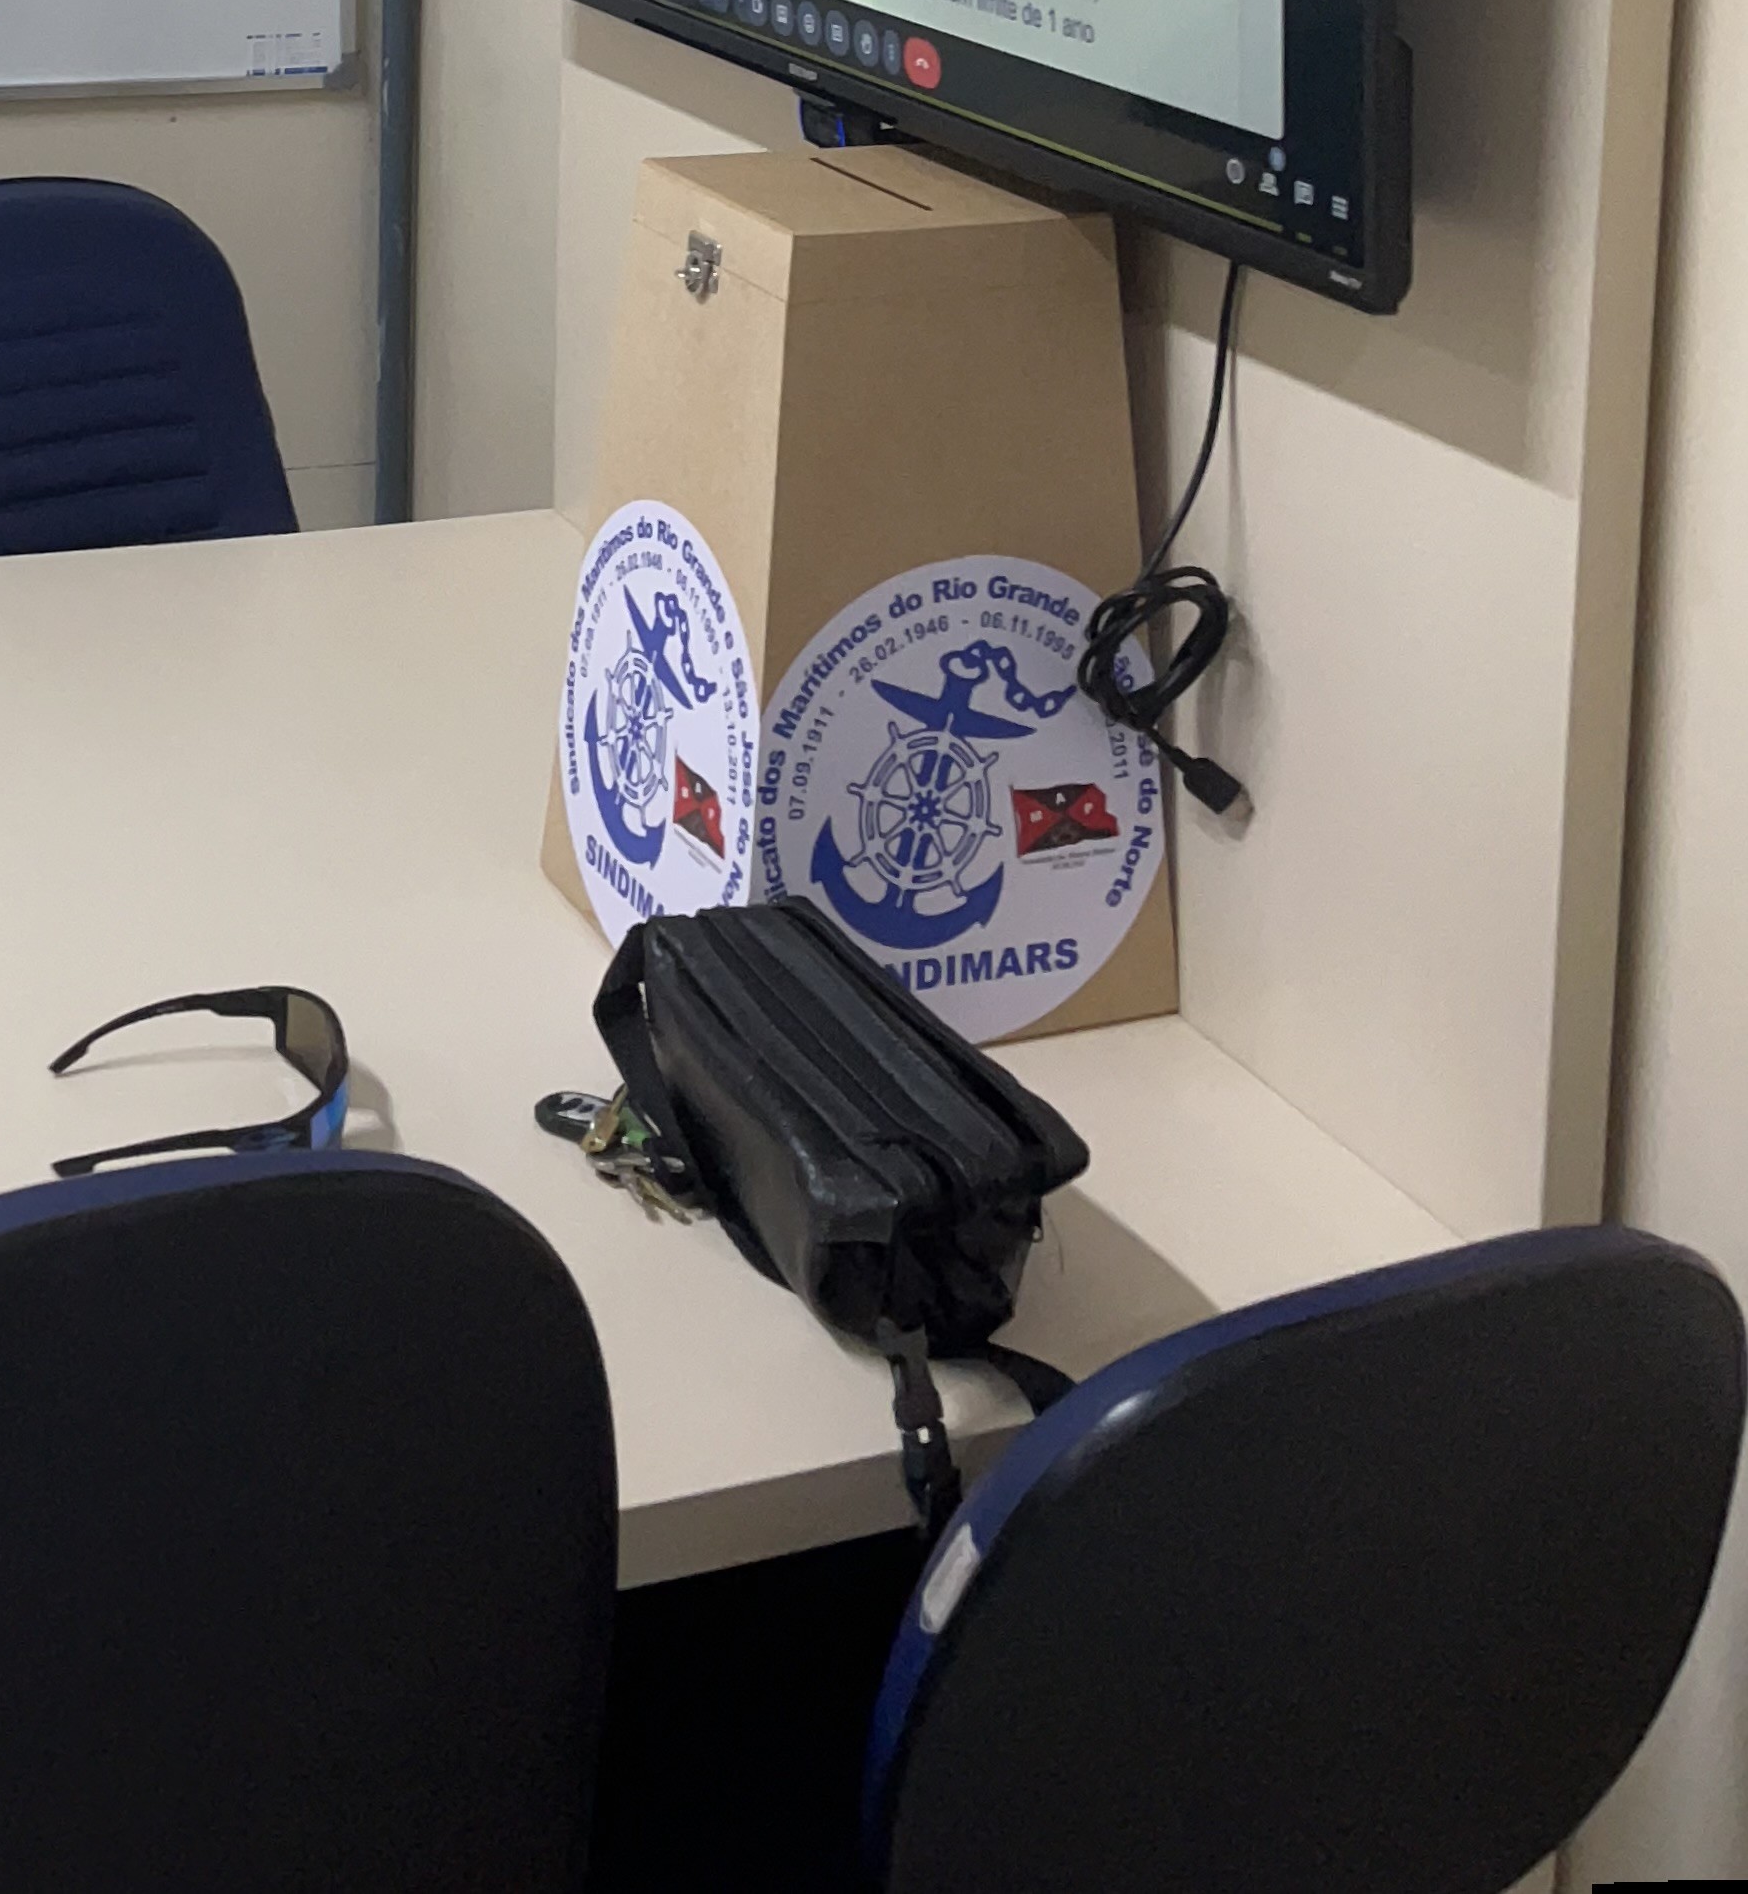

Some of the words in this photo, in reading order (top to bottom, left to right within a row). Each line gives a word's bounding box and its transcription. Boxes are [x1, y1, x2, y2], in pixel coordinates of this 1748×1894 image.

[1022, 2, 1042, 28] de
[1049, 8, 1056, 32] 1
[1062, 17, 1094, 43] ano
[637, 515, 653, 538] do
[657, 519, 678, 550] Rio
[682, 540, 725, 624] Grande
[731, 657, 748, 719] São
[758, 750, 786, 805] dos
[772, 614, 882, 739] Marítimos
[889, 593, 923, 619] do
[932, 577, 977, 603] Rio
[988, 576, 1080, 626] Grande
[788, 706, 834, 820] 07.09.1911
[849, 615, 949, 683] 26.02.1946
[740, 731, 753, 807] José
[1138, 778, 1158, 815] do
[736, 817, 750, 855] do
[1106, 824, 1153, 907] Norte
[585, 834, 664, 917] SINDIM
[884, 938, 1079, 991] NDIMARS
